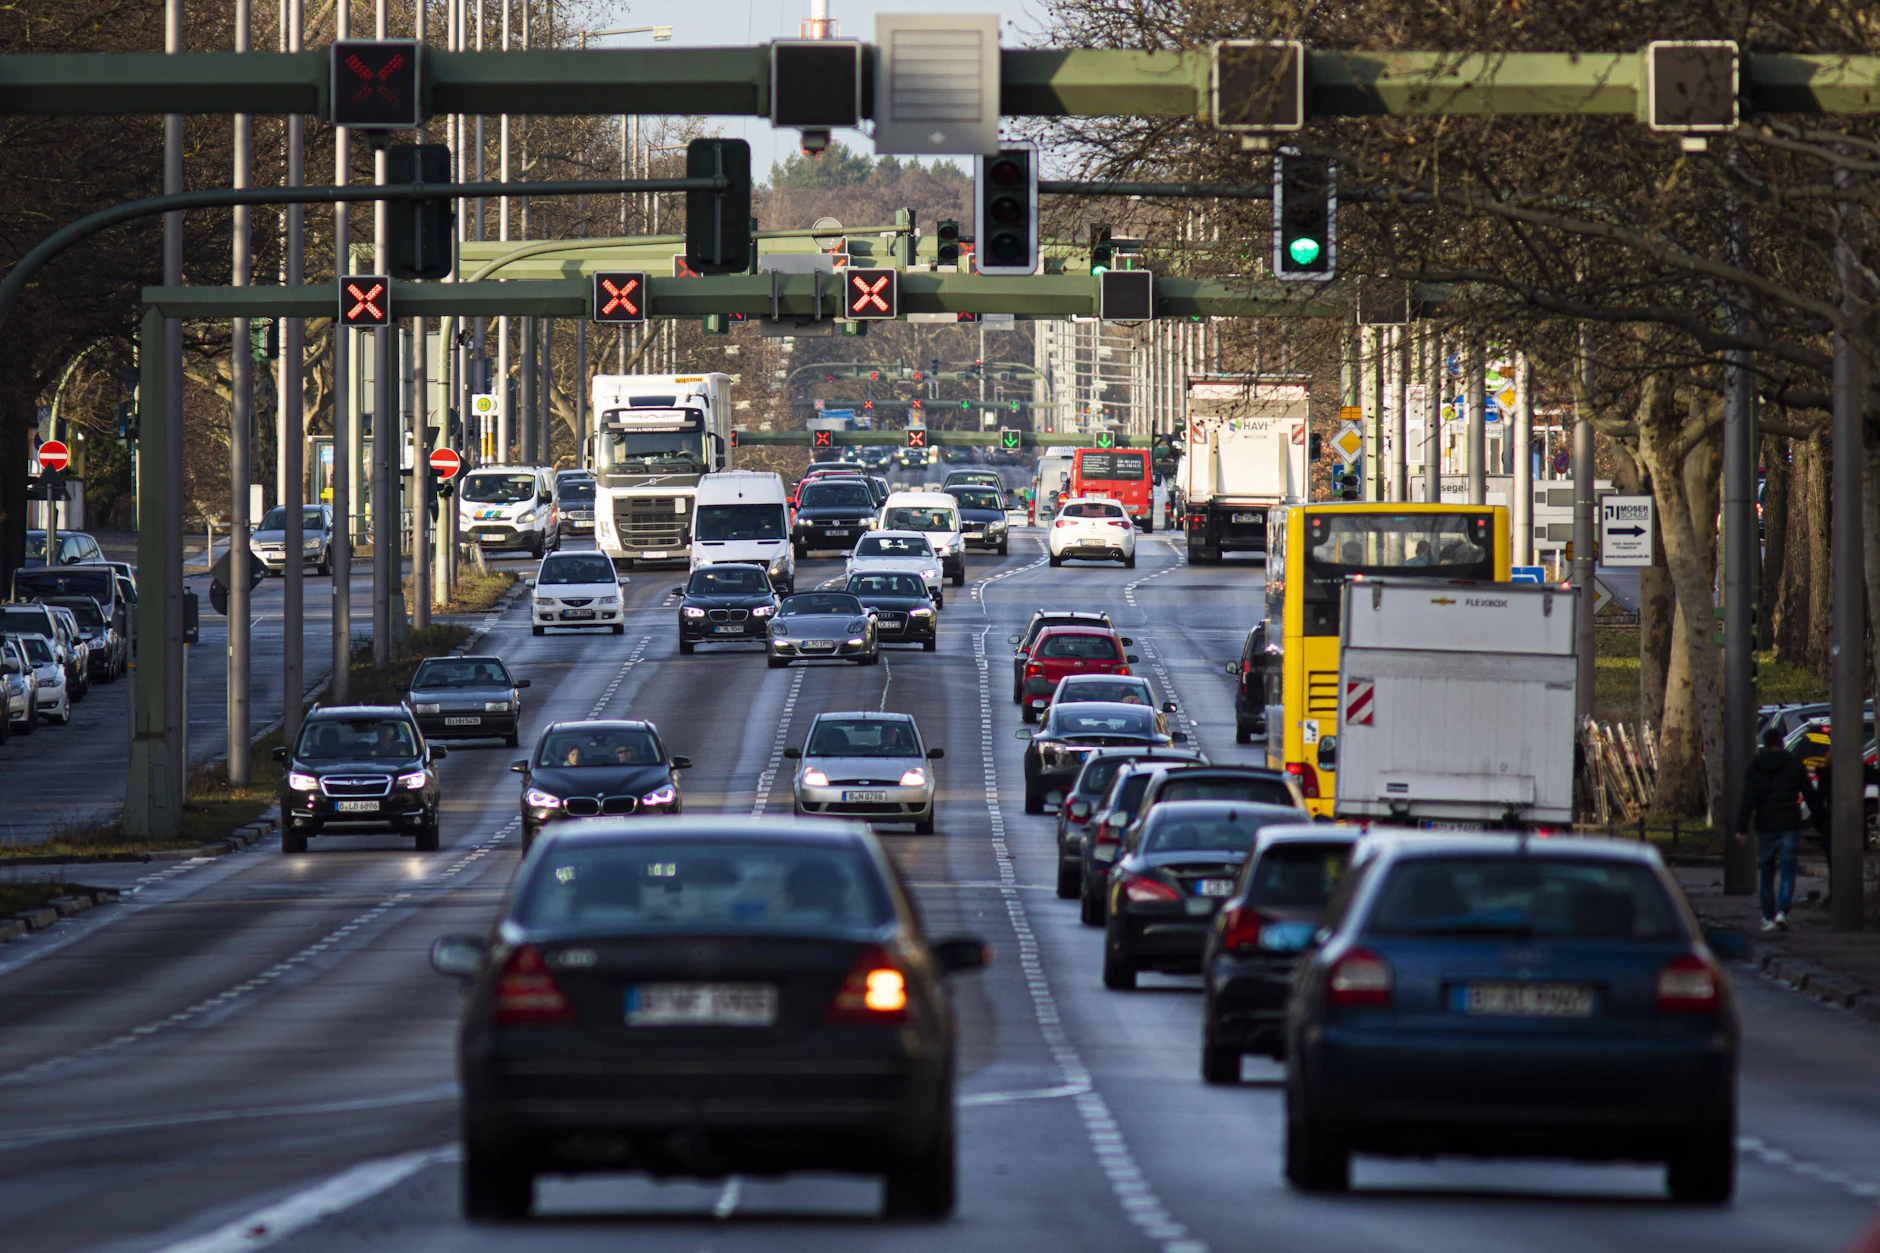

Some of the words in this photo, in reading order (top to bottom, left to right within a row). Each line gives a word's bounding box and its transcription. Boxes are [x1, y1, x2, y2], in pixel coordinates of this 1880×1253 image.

[1243, 421, 1268, 431] HAVI
[1465, 598, 1508, 608] FLEXBOX
[360, 802, 378, 810] 6896
